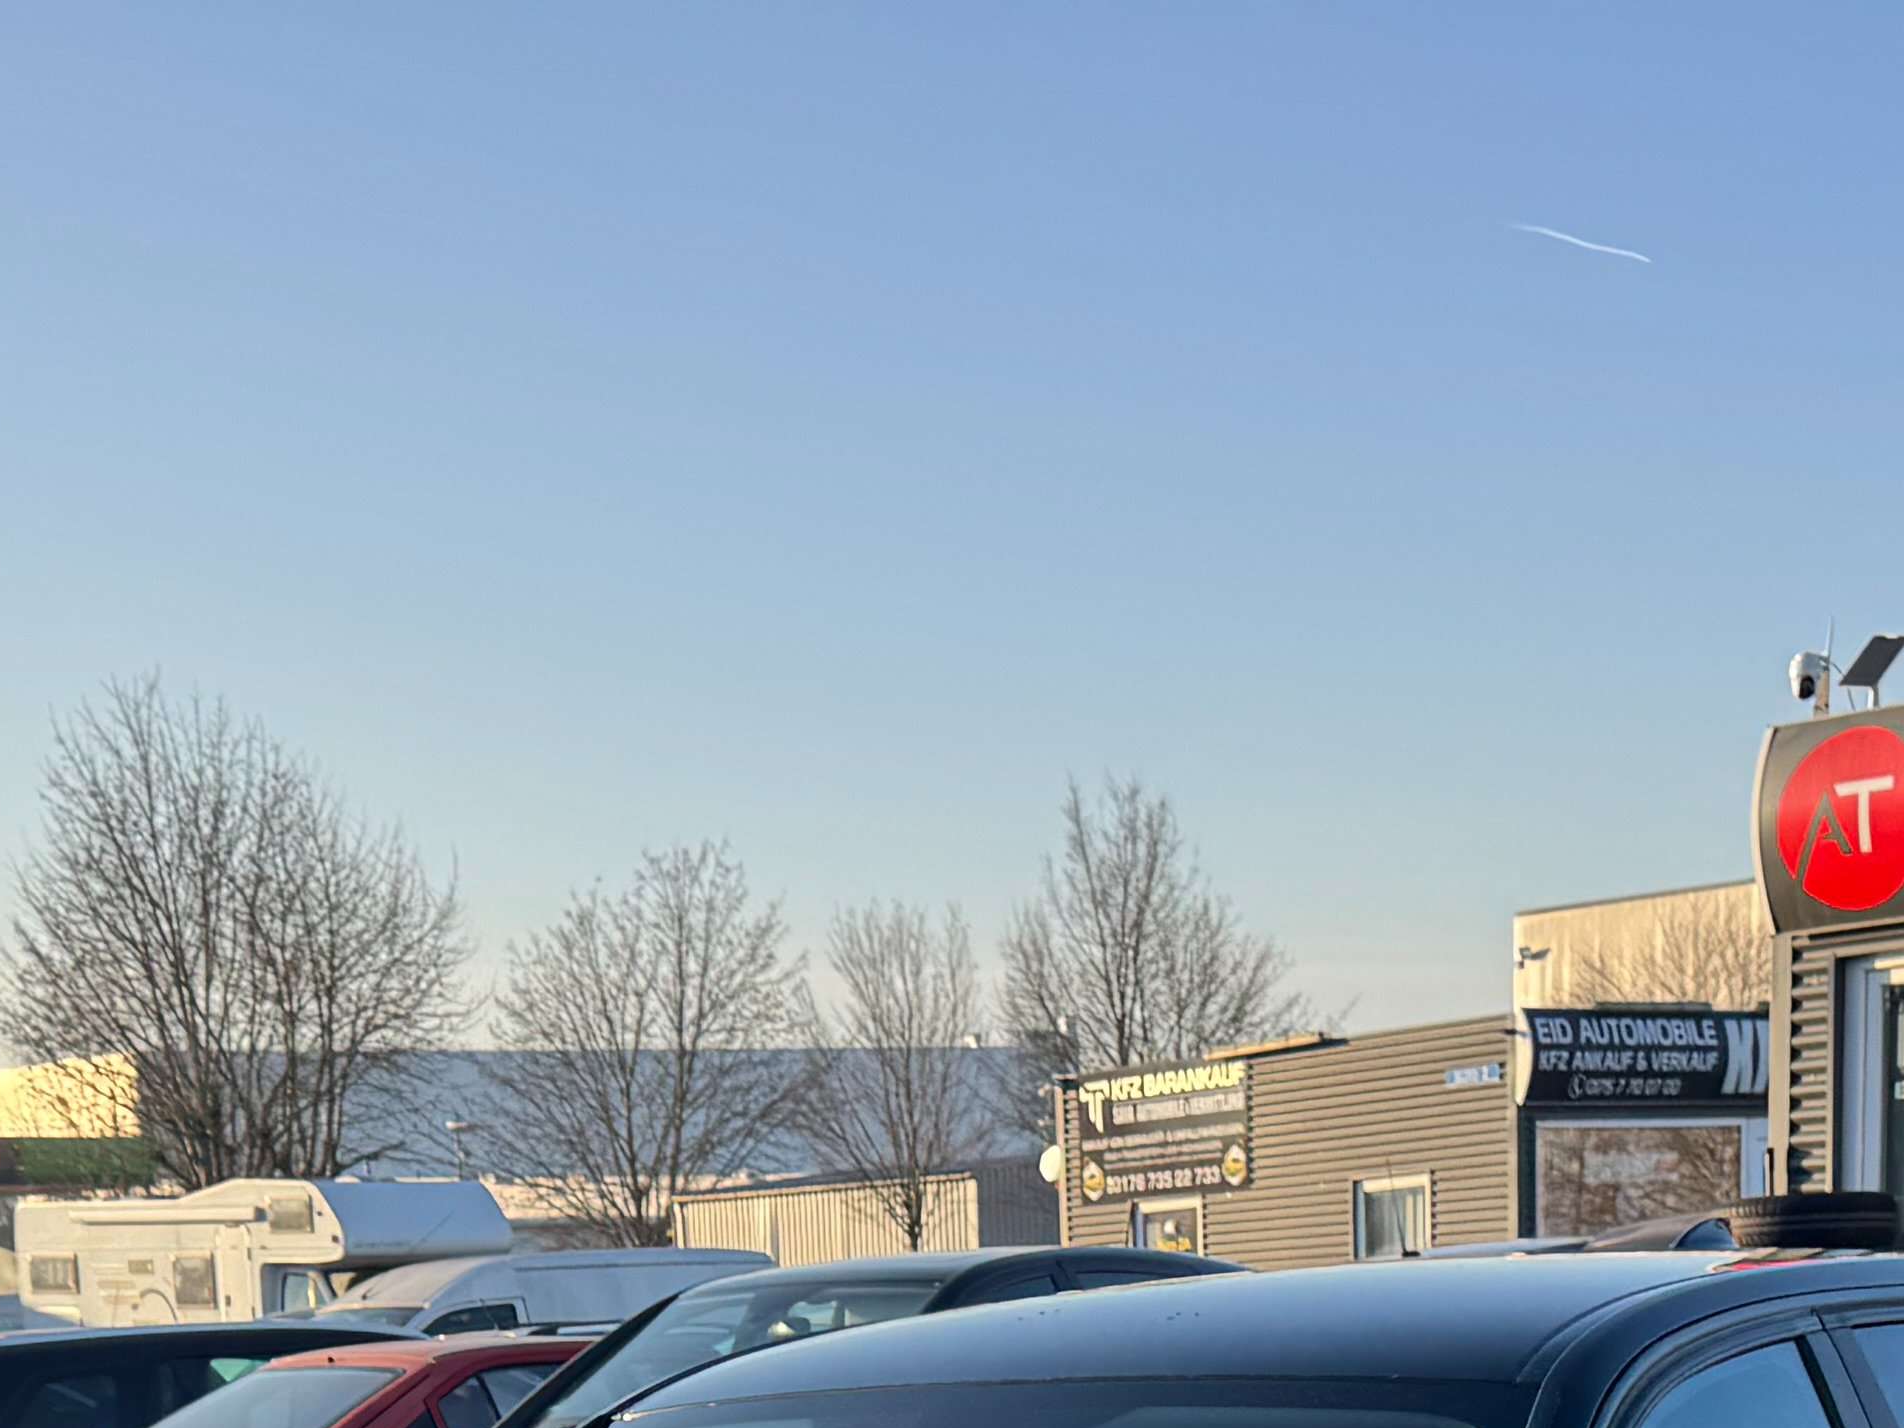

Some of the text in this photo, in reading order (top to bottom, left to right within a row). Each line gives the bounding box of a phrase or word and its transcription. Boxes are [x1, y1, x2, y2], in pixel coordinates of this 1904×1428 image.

[1534, 1018, 1719, 1047] EID AUTOMOBILE
[1537, 1051, 1568, 1072] KFZ
[1572, 1051, 1633, 1072] ANKAUF
[1651, 1051, 1719, 1073] VERKAUF
[1110, 1061, 1246, 1101] KFZ BARANKAUF
